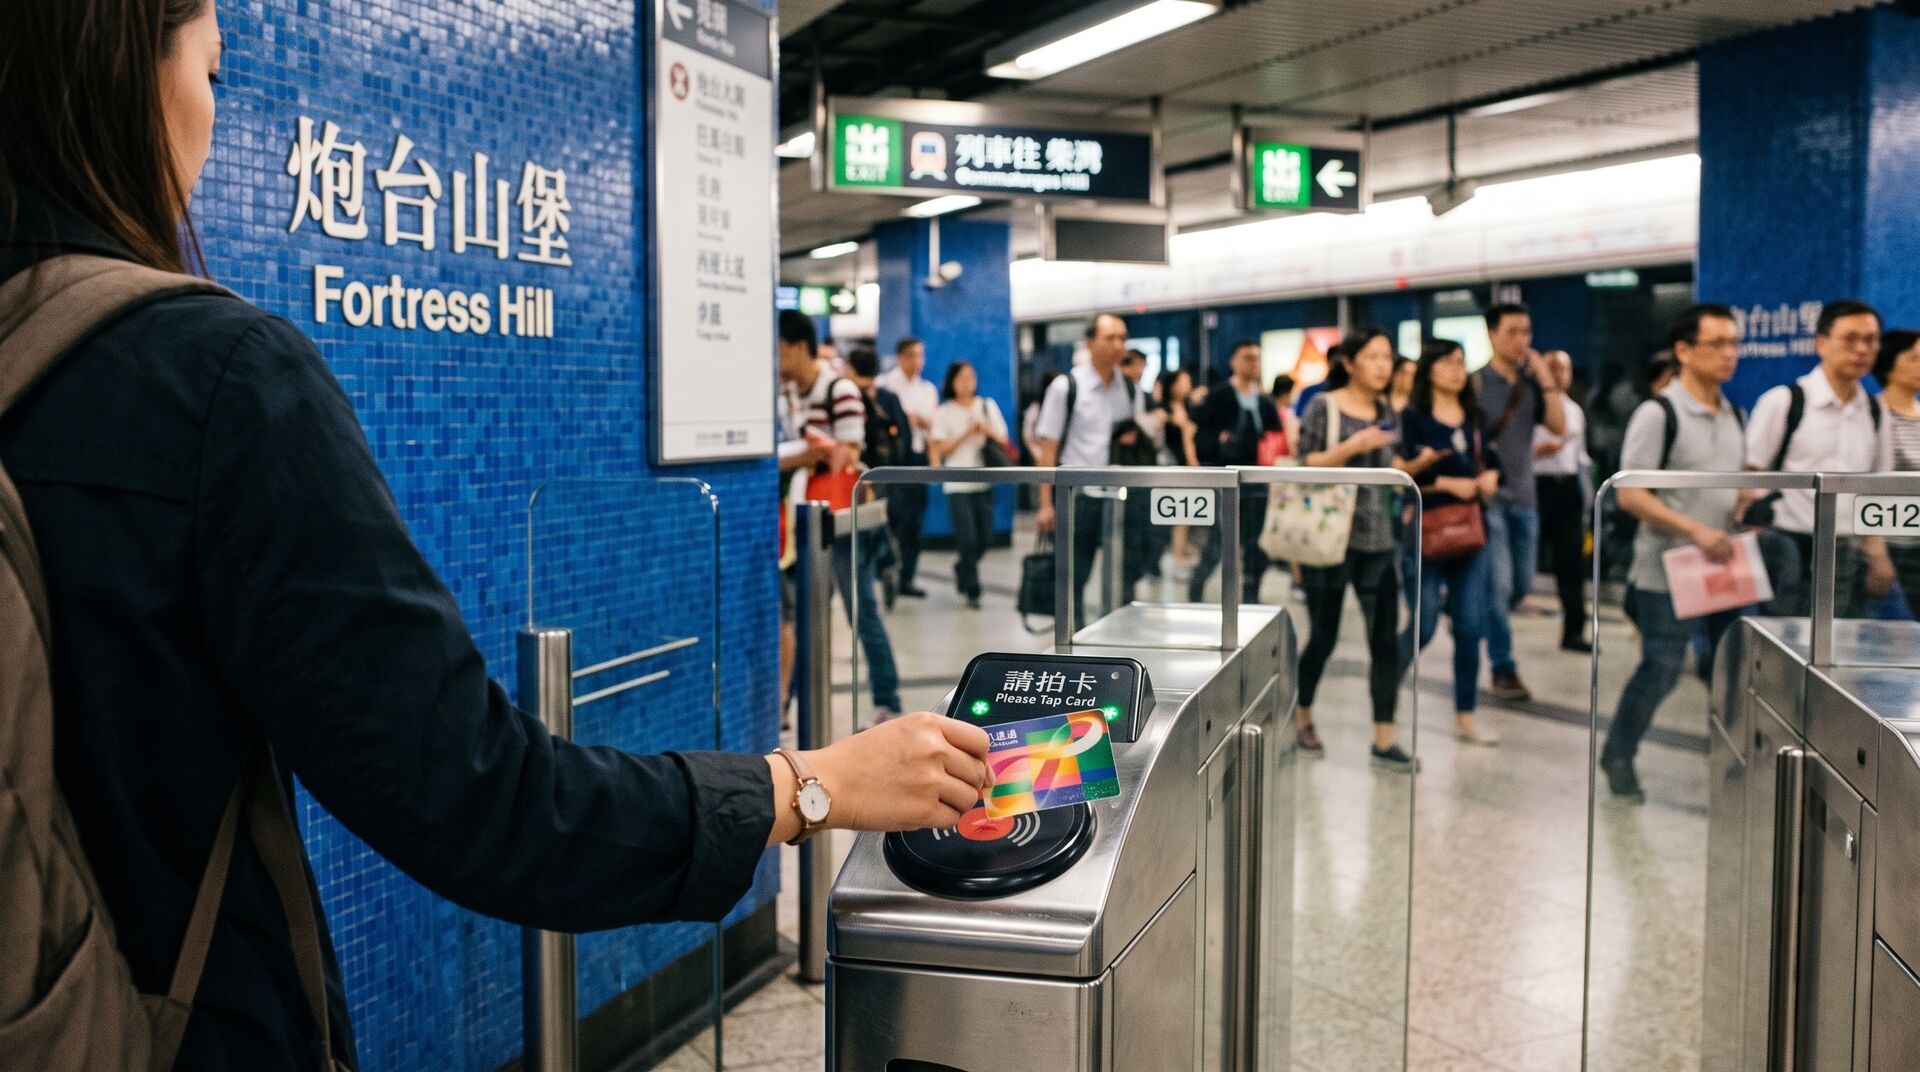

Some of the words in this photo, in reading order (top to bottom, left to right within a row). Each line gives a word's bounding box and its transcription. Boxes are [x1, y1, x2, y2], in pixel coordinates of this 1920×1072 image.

[845, 123, 889, 163] 出
[845, 164, 887, 182] EXIT
[1262, 148, 1301, 186] 出
[286, 115, 574, 268] 炮台山堡
[314, 264, 491, 335] Fortress
[499, 284, 554, 339] Hill
[1157, 495, 1208, 518] G12
[1860, 502, 1920, 528] G12
[1002, 670, 1098, 694] 請拍卡
[995, 693, 1037, 705] Please
[1040, 694, 1062, 707] Tap
[1065, 695, 1096, 707] Card
